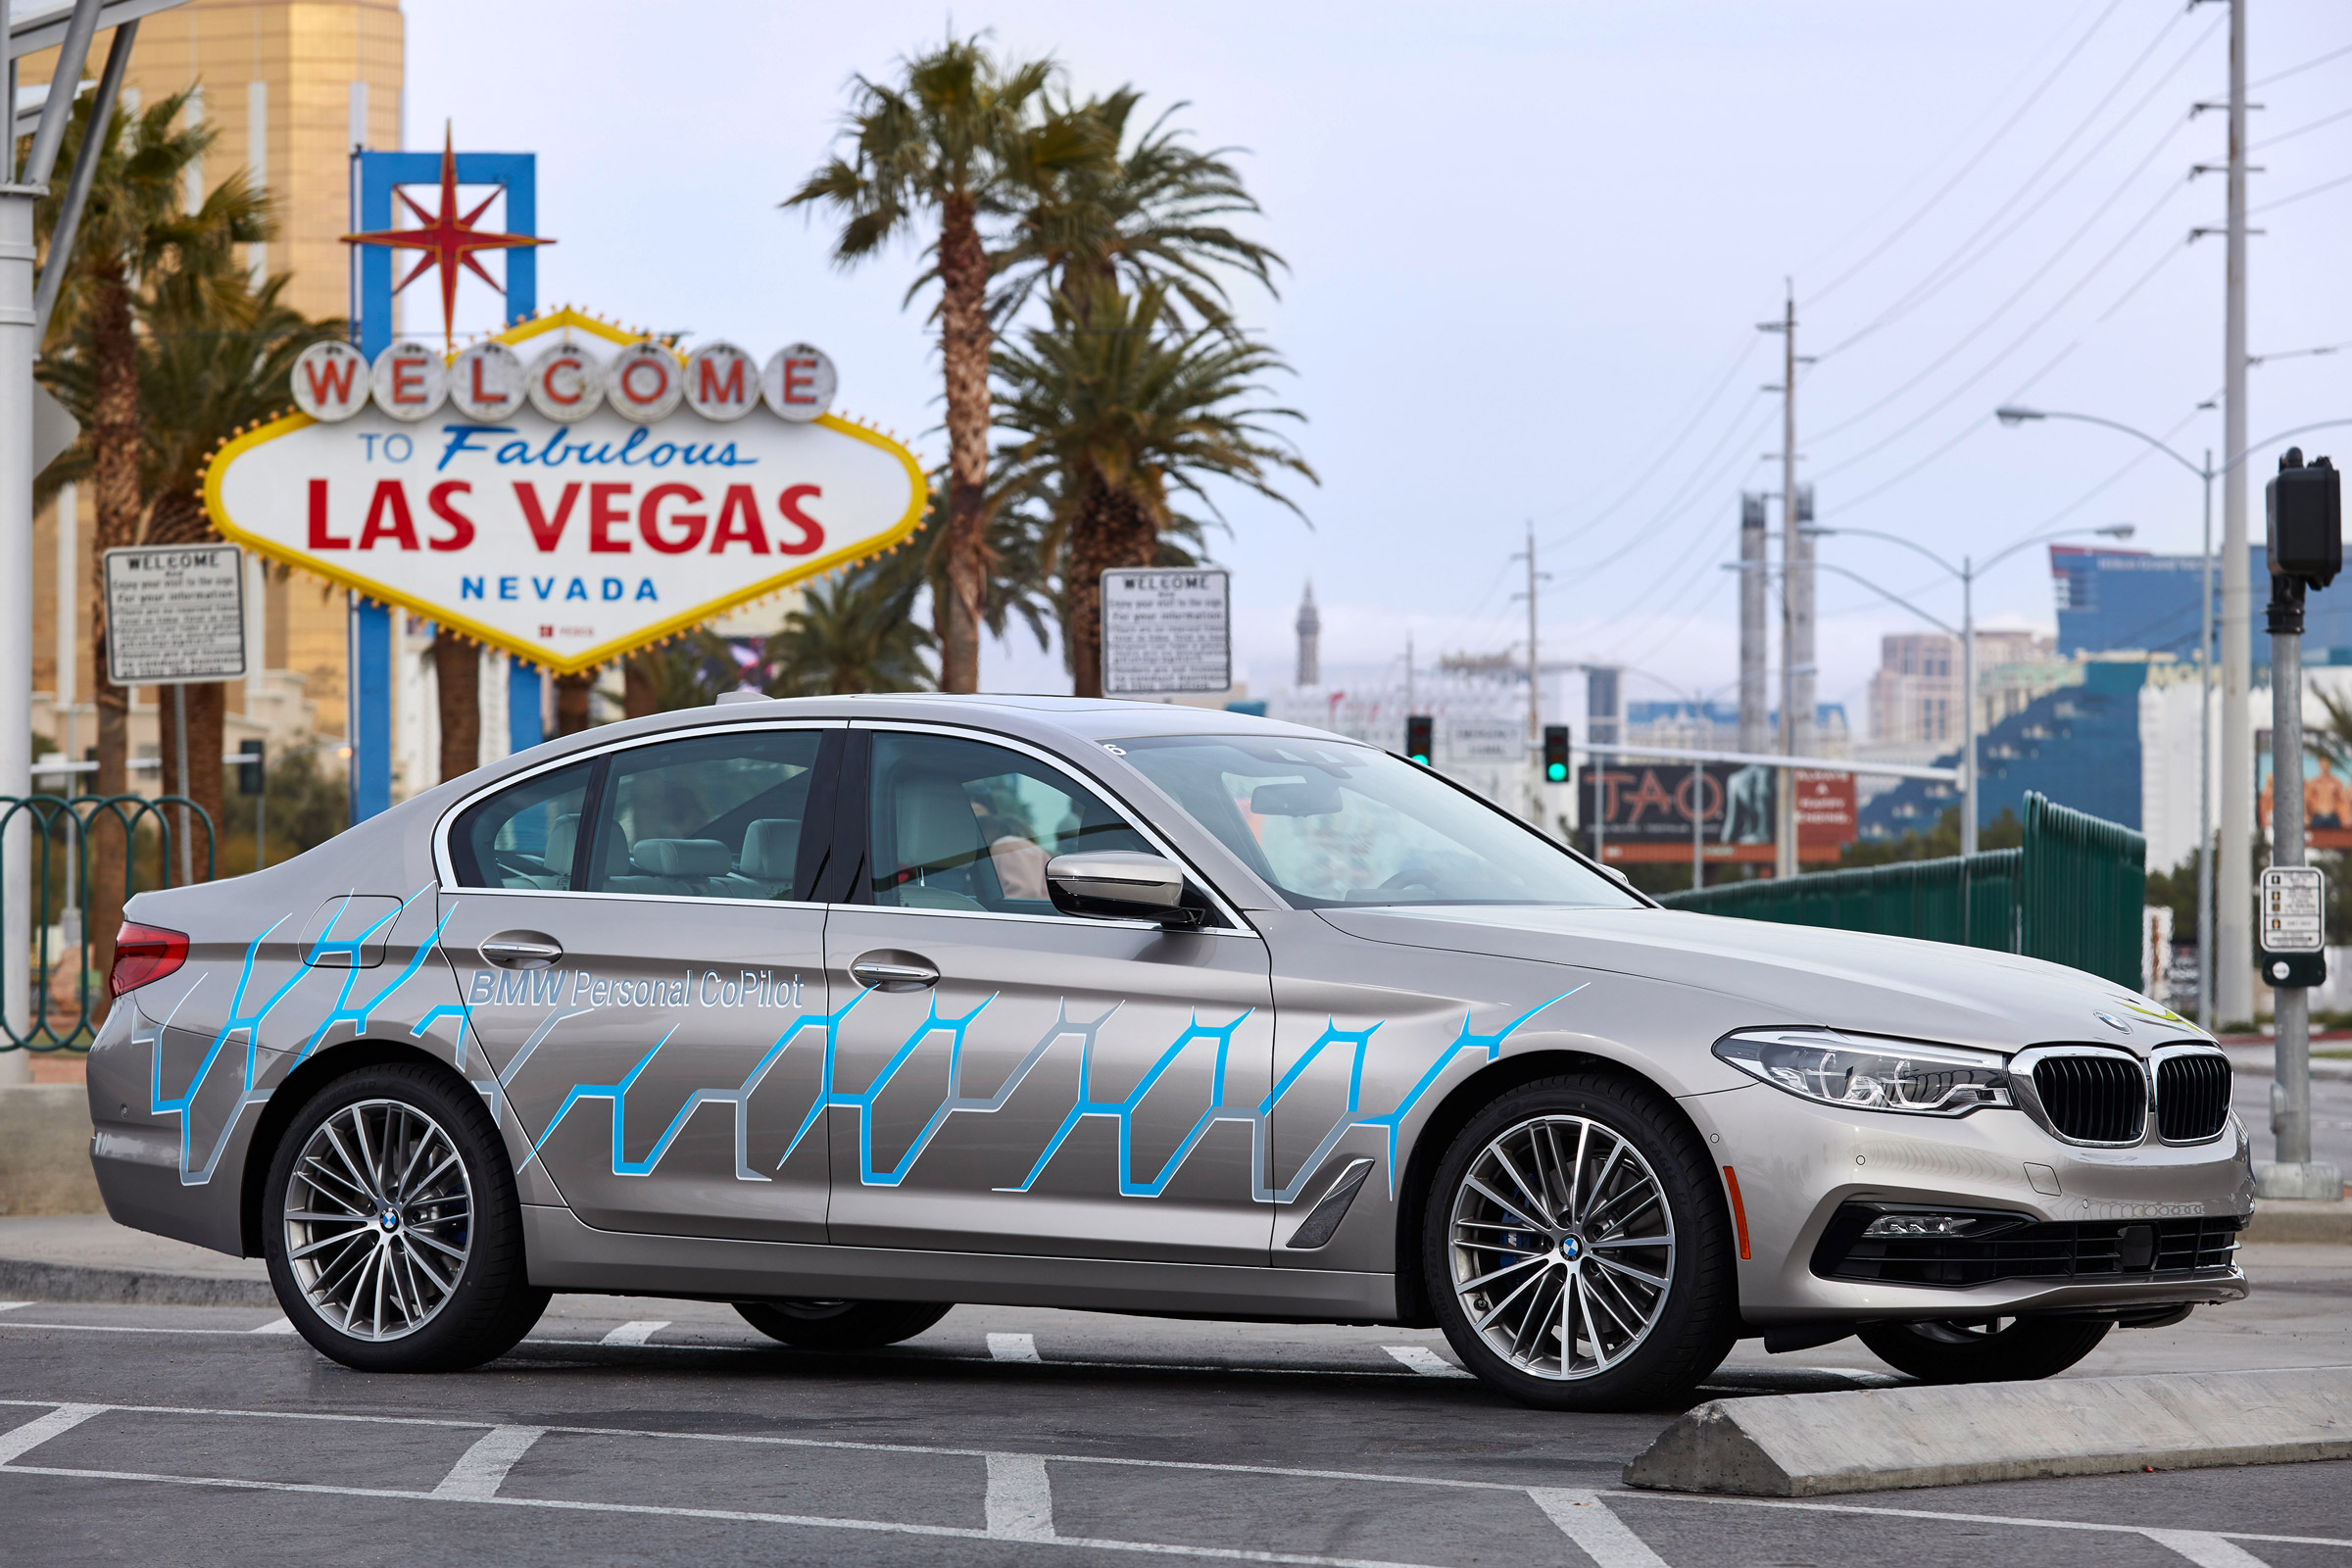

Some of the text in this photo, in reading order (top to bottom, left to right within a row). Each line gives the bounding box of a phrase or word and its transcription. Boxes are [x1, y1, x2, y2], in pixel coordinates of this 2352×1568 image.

[304, 358, 817, 406] WELCOME
[358, 425, 760, 471] TO Fabulous
[307, 478, 827, 557] LAS VEGAS
[127, 553, 220, 570] WELCOME
[461, 575, 660, 603] NEVADA
[1123, 576, 1209, 591] WELCOME
[1584, 768, 1724, 825] TAO
[466, 969, 806, 1008] BMW Personal CoPilot
